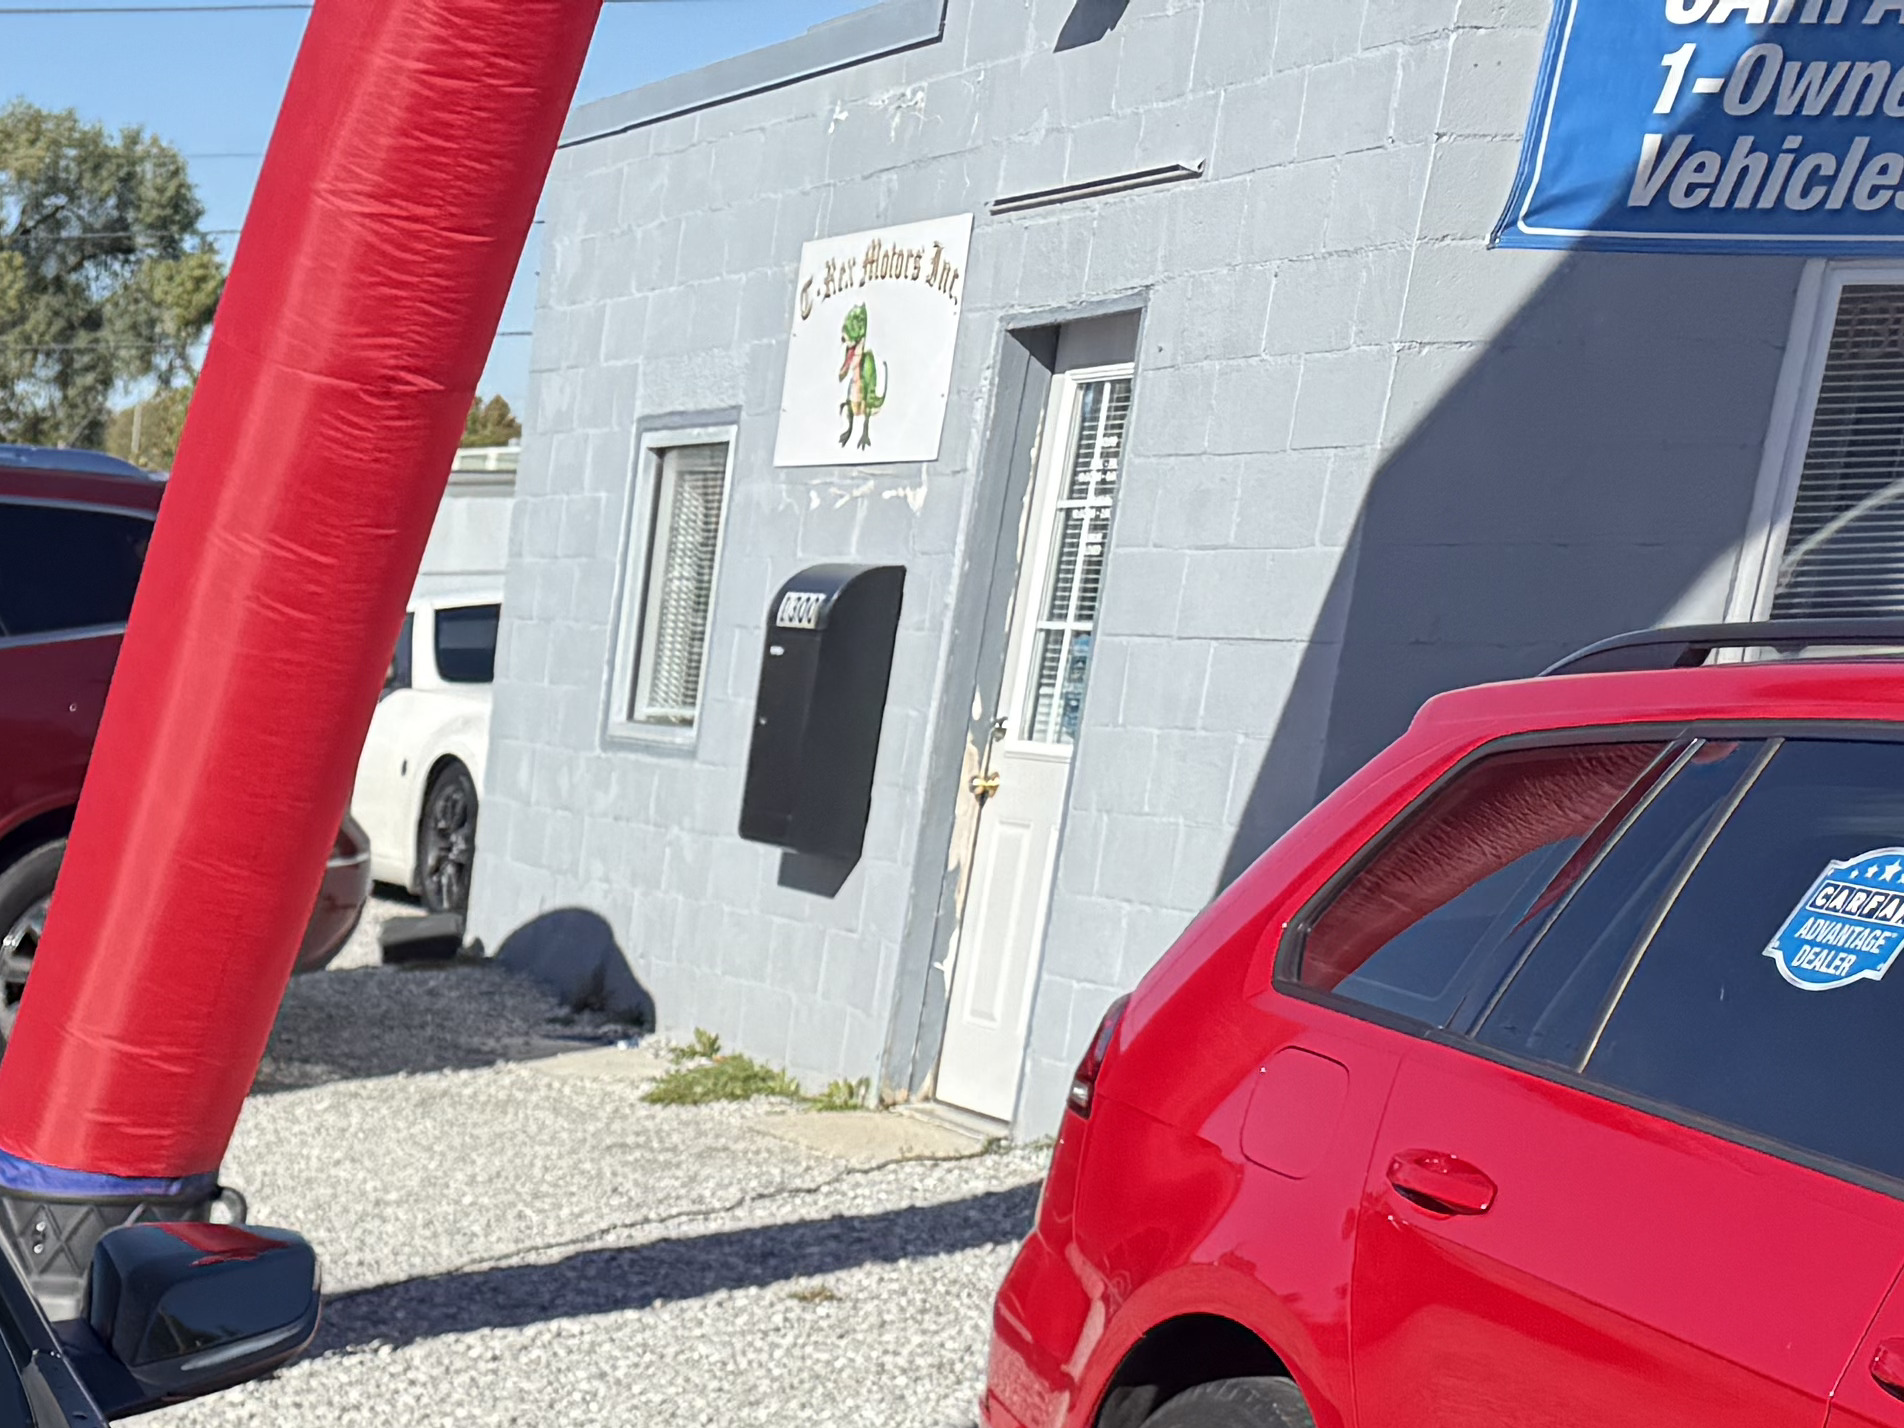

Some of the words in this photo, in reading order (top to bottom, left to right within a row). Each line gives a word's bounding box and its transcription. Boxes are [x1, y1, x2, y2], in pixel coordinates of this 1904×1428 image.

[1627, 133, 1904, 211] Vehicle
[859, 238, 924, 287] Motors
[1814, 885, 1904, 924] CARFA
[1794, 916, 1888, 954] ADVANTAGE
[1791, 944, 1857, 976] DEALER
